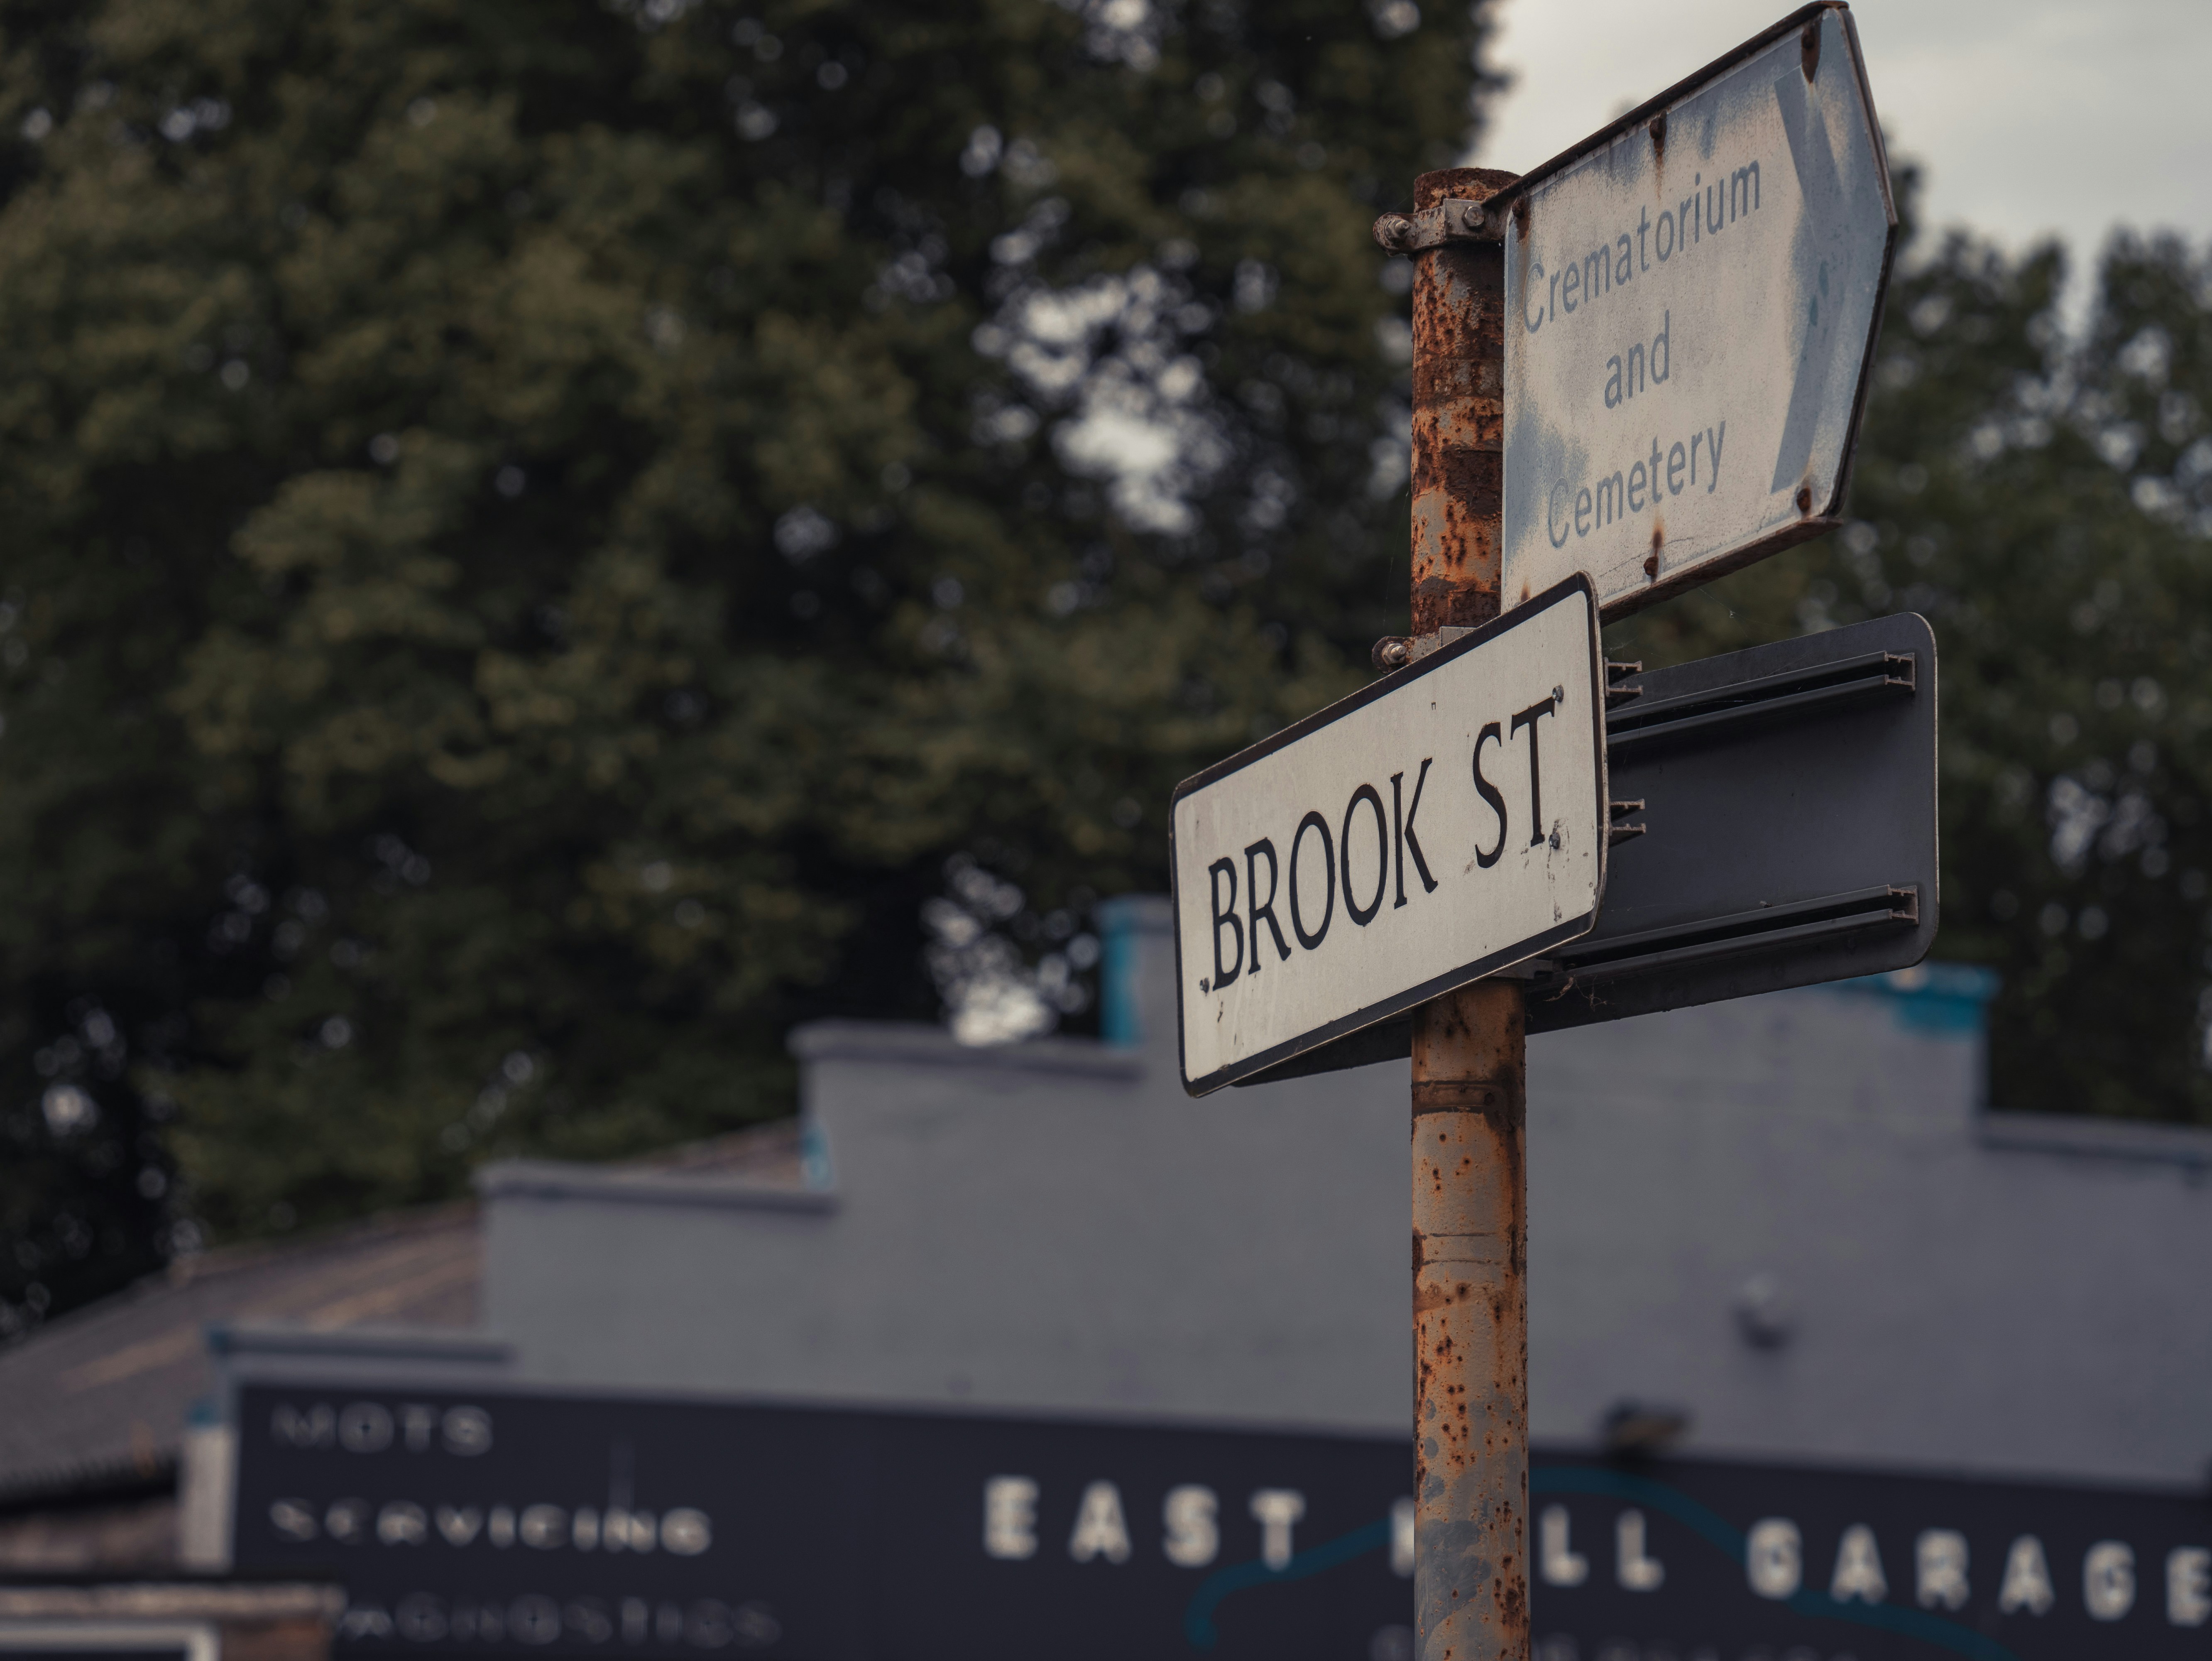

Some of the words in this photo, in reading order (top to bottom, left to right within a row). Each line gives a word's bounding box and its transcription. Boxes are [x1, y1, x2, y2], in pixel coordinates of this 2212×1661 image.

[1523, 161, 1761, 333] Crematorium
[1604, 311, 1671, 409] and
[1549, 421, 1726, 549] Cemetery
[1209, 757, 1439, 991] BROOK
[1472, 696, 1555, 868] ST
[271, 1403, 493, 1457] MOTS
[270, 1497, 712, 1555] SERVICING
[984, 1475, 1306, 1571] EAST
[1746, 1516, 2212, 1625] GARAGE
